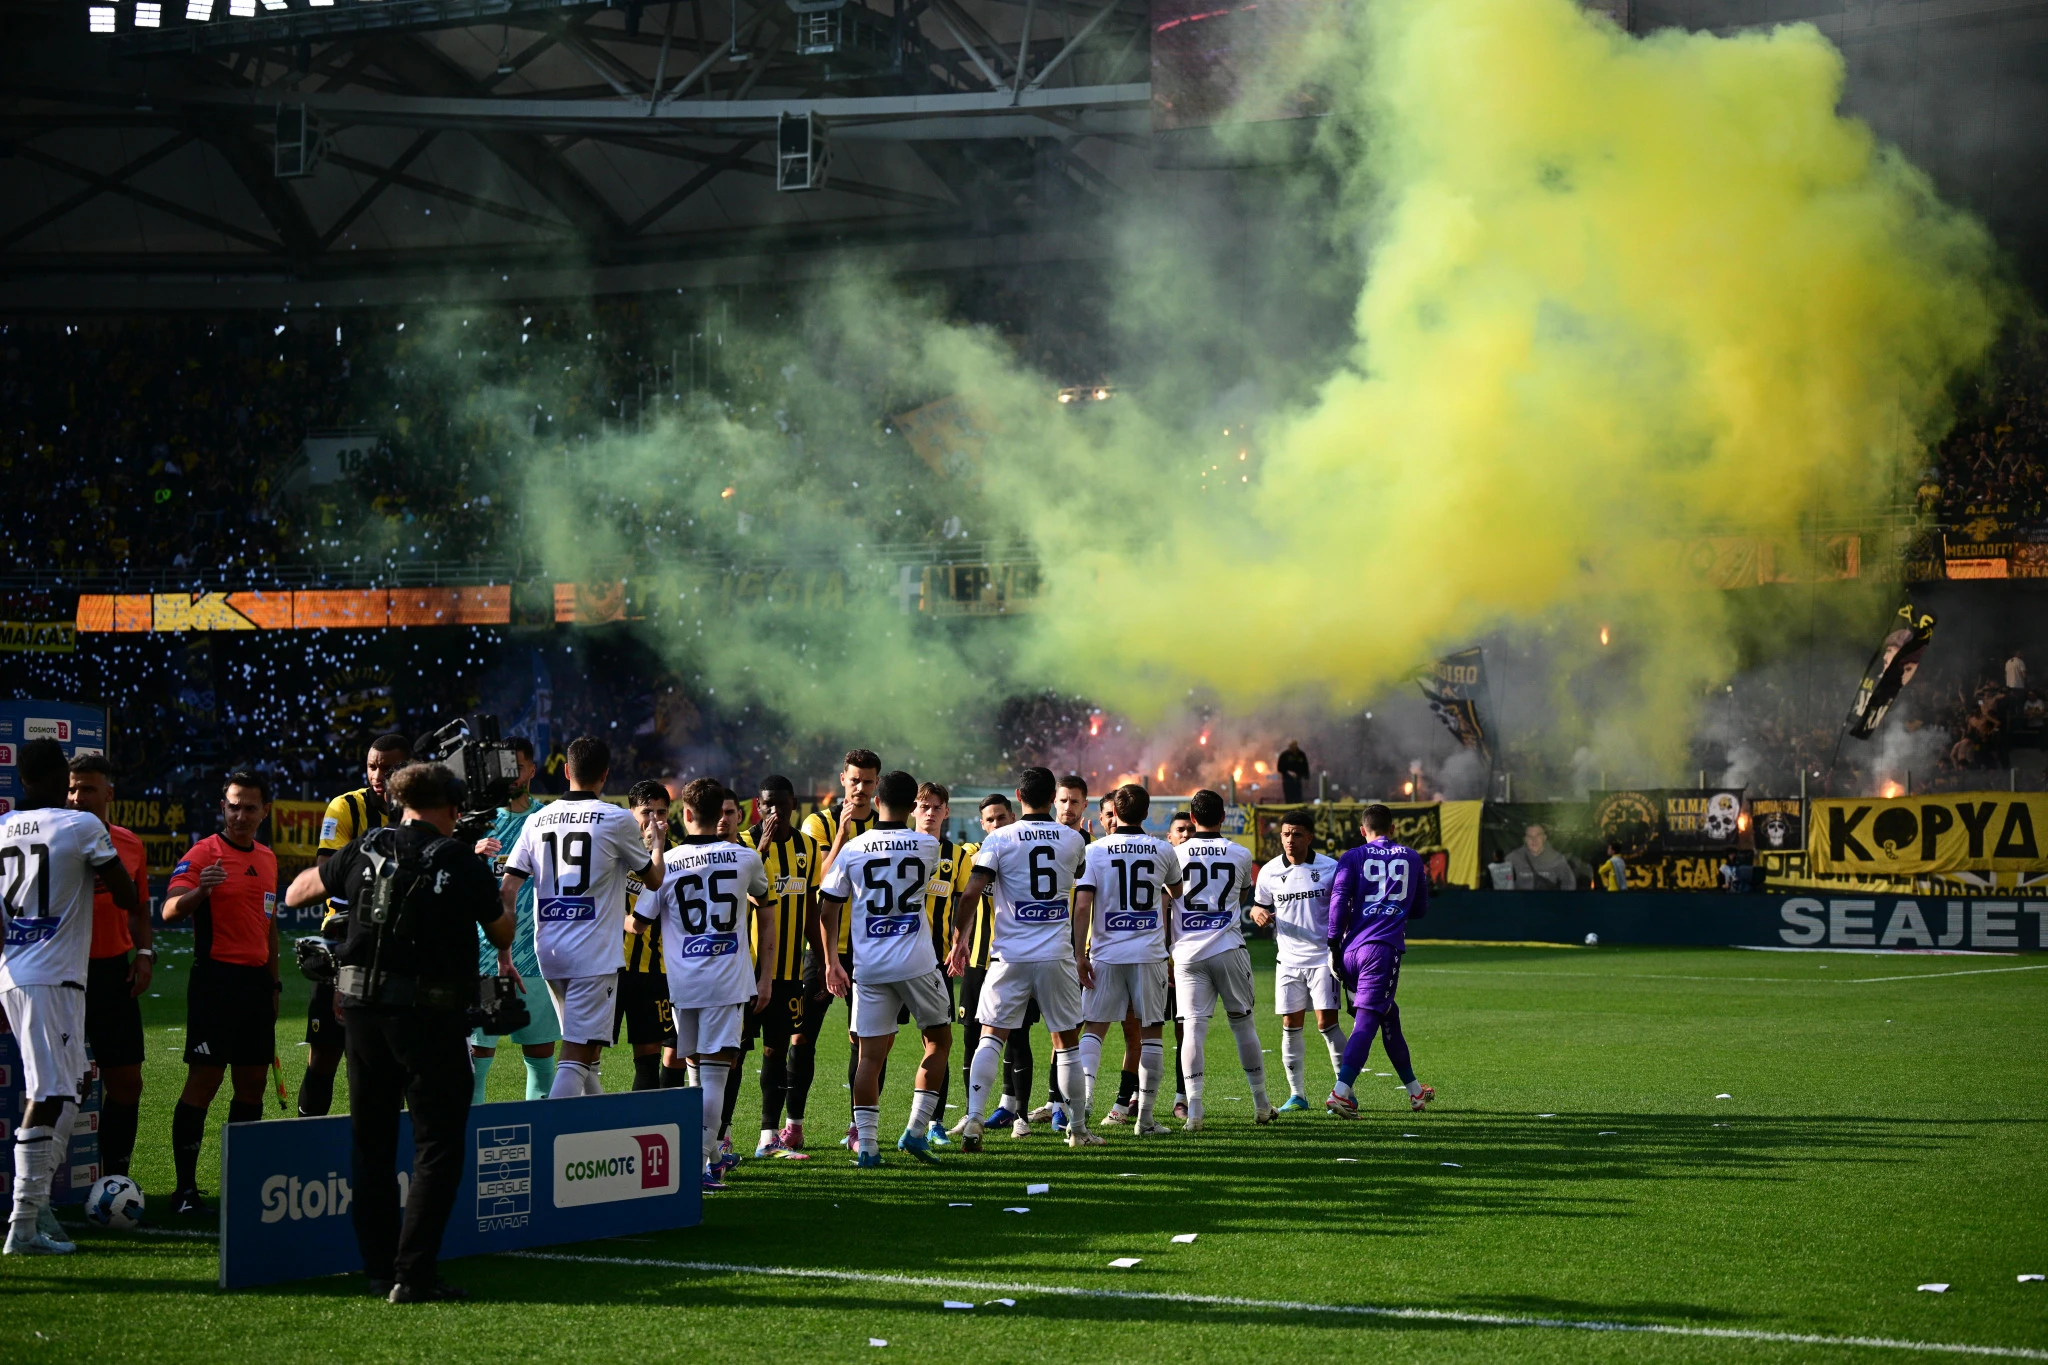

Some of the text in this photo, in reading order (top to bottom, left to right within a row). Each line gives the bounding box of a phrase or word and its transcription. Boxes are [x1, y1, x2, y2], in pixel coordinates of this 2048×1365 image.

[7, 820, 39, 838] BABA
[534, 812, 605, 828] JEREMEJEFF
[863, 840, 919, 854] ΧΑΤΣΙΔΗΣ
[1018, 830, 1060, 841] LOVREN
[1107, 844, 1158, 855] KEDZIORA
[1188, 847, 1227, 857] OZDOEV
[541, 832, 592, 896] 19
[667, 851, 738, 874] ΚΩΝΣΤΑΝΤΕΛΙΑΣ
[1029, 846, 1057, 900] 6
[863, 857, 926, 916] 52
[1111, 859, 1155, 911] 16
[1183, 862, 1236, 911] 27
[1363, 859, 1410, 902] 99
[674, 870, 738, 935] 65
[1277, 889, 1326, 902] SUPERBET
[655, 999, 672, 1023] 12
[788, 997, 804, 1020] 90
[484, 1147, 526, 1162] SUPER
[565, 1156, 635, 1181] COSMOTE
[479, 1180, 529, 1196] LEAGUE
